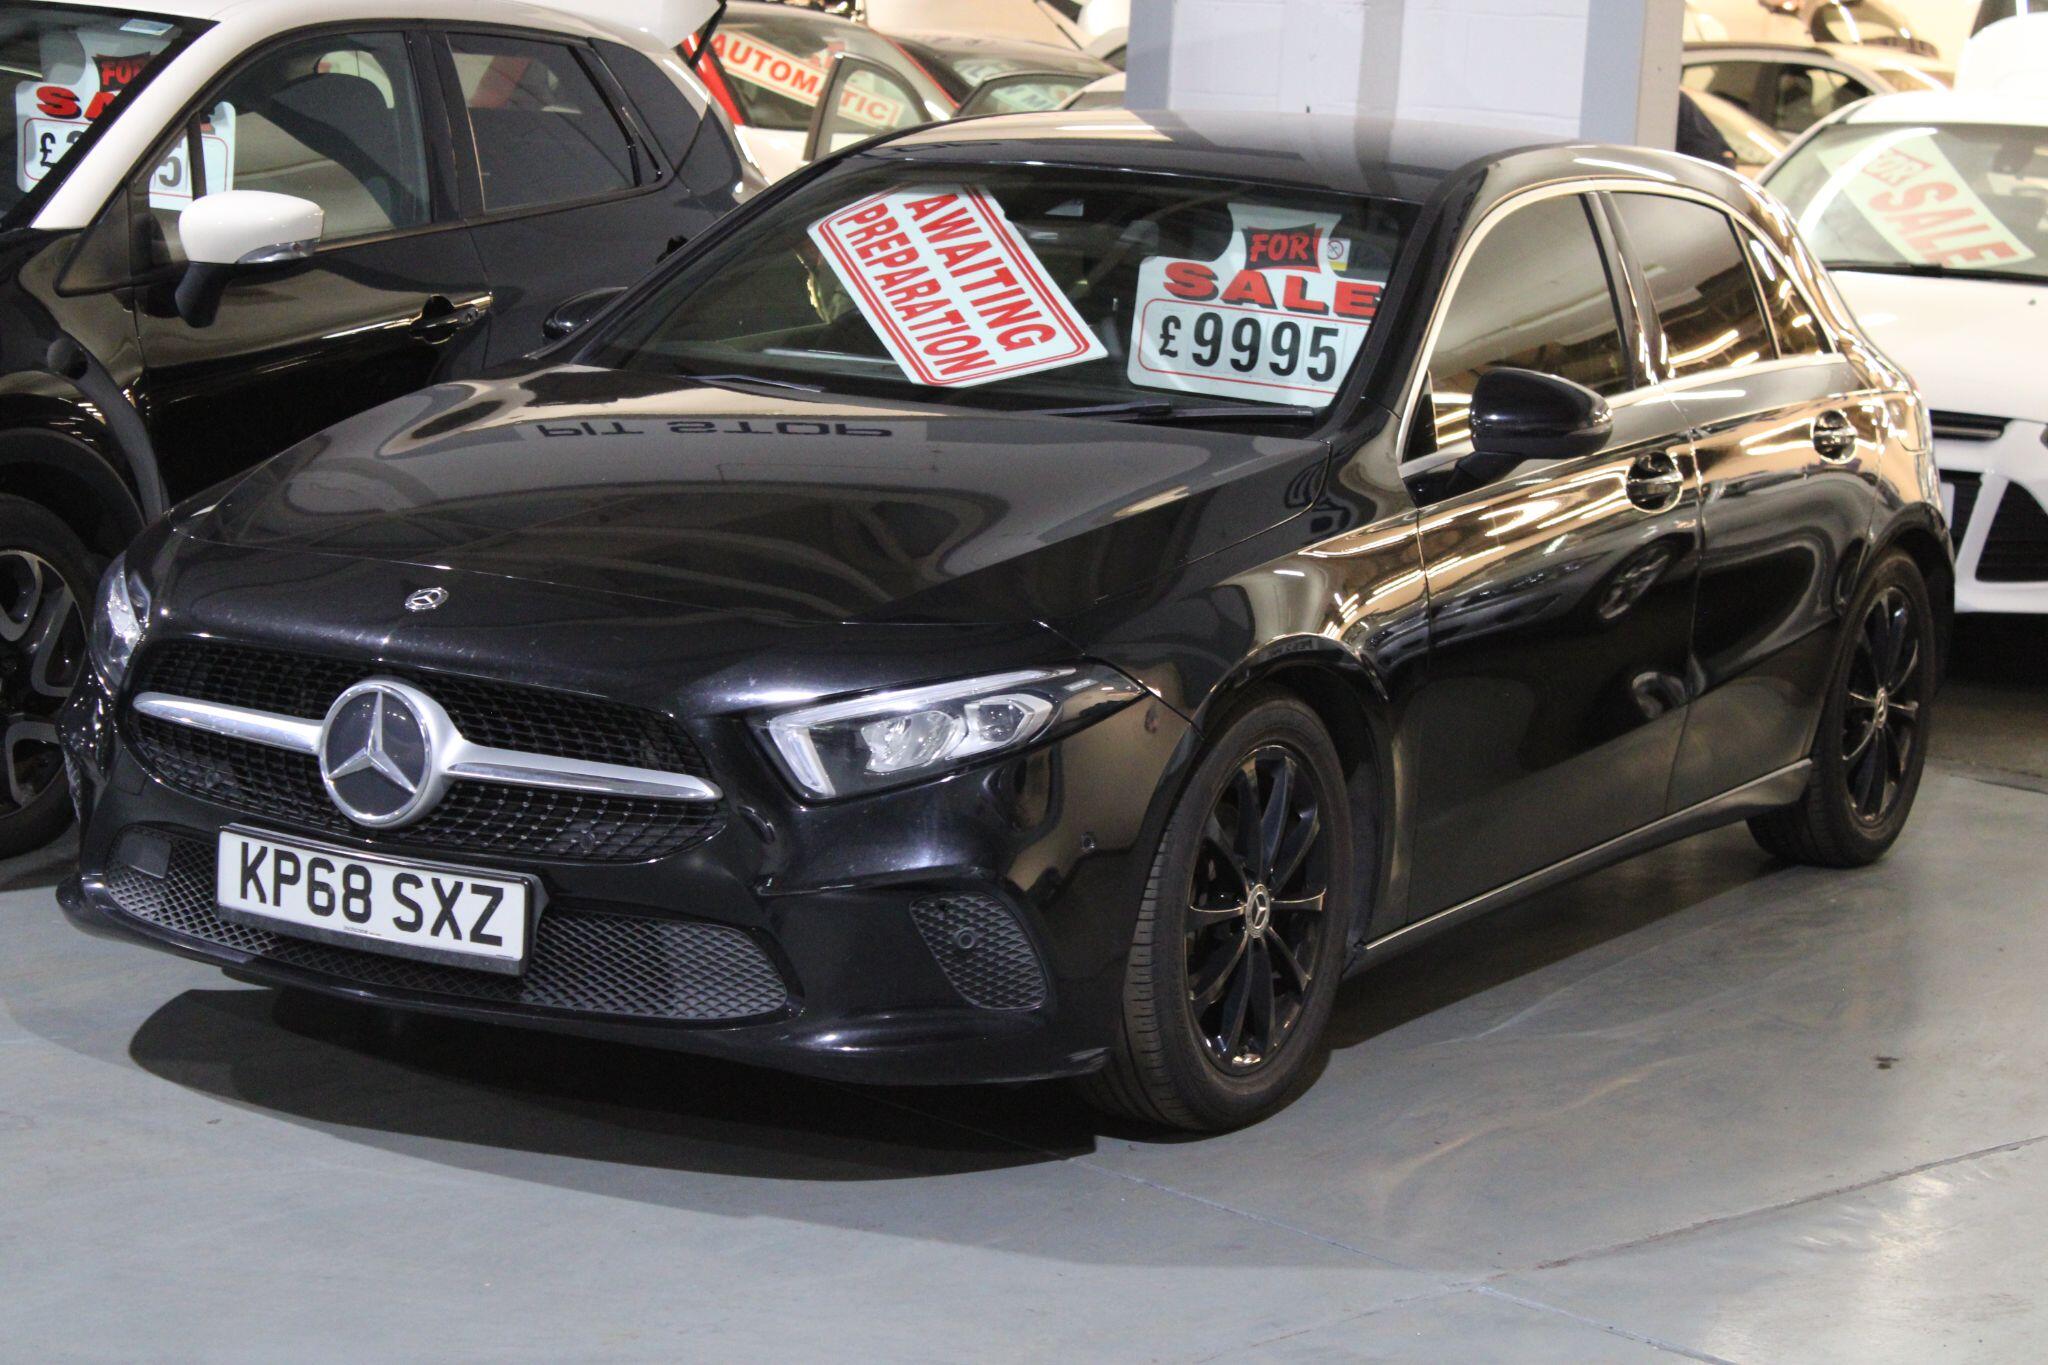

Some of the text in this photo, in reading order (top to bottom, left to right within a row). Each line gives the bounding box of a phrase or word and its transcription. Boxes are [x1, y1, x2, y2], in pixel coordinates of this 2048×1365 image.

[102, 60, 143, 85] FO
[711, 33, 889, 121] AUTOMTIC
[903, 193, 1058, 350] AWAITING
[1249, 230, 1310, 263] FOR
[837, 202, 997, 377] PREPARATION
[1163, 261, 1384, 318] SALE
[1158, 311, 1340, 382] £9995
[240, 841, 505, 948] KP68 SXZ
